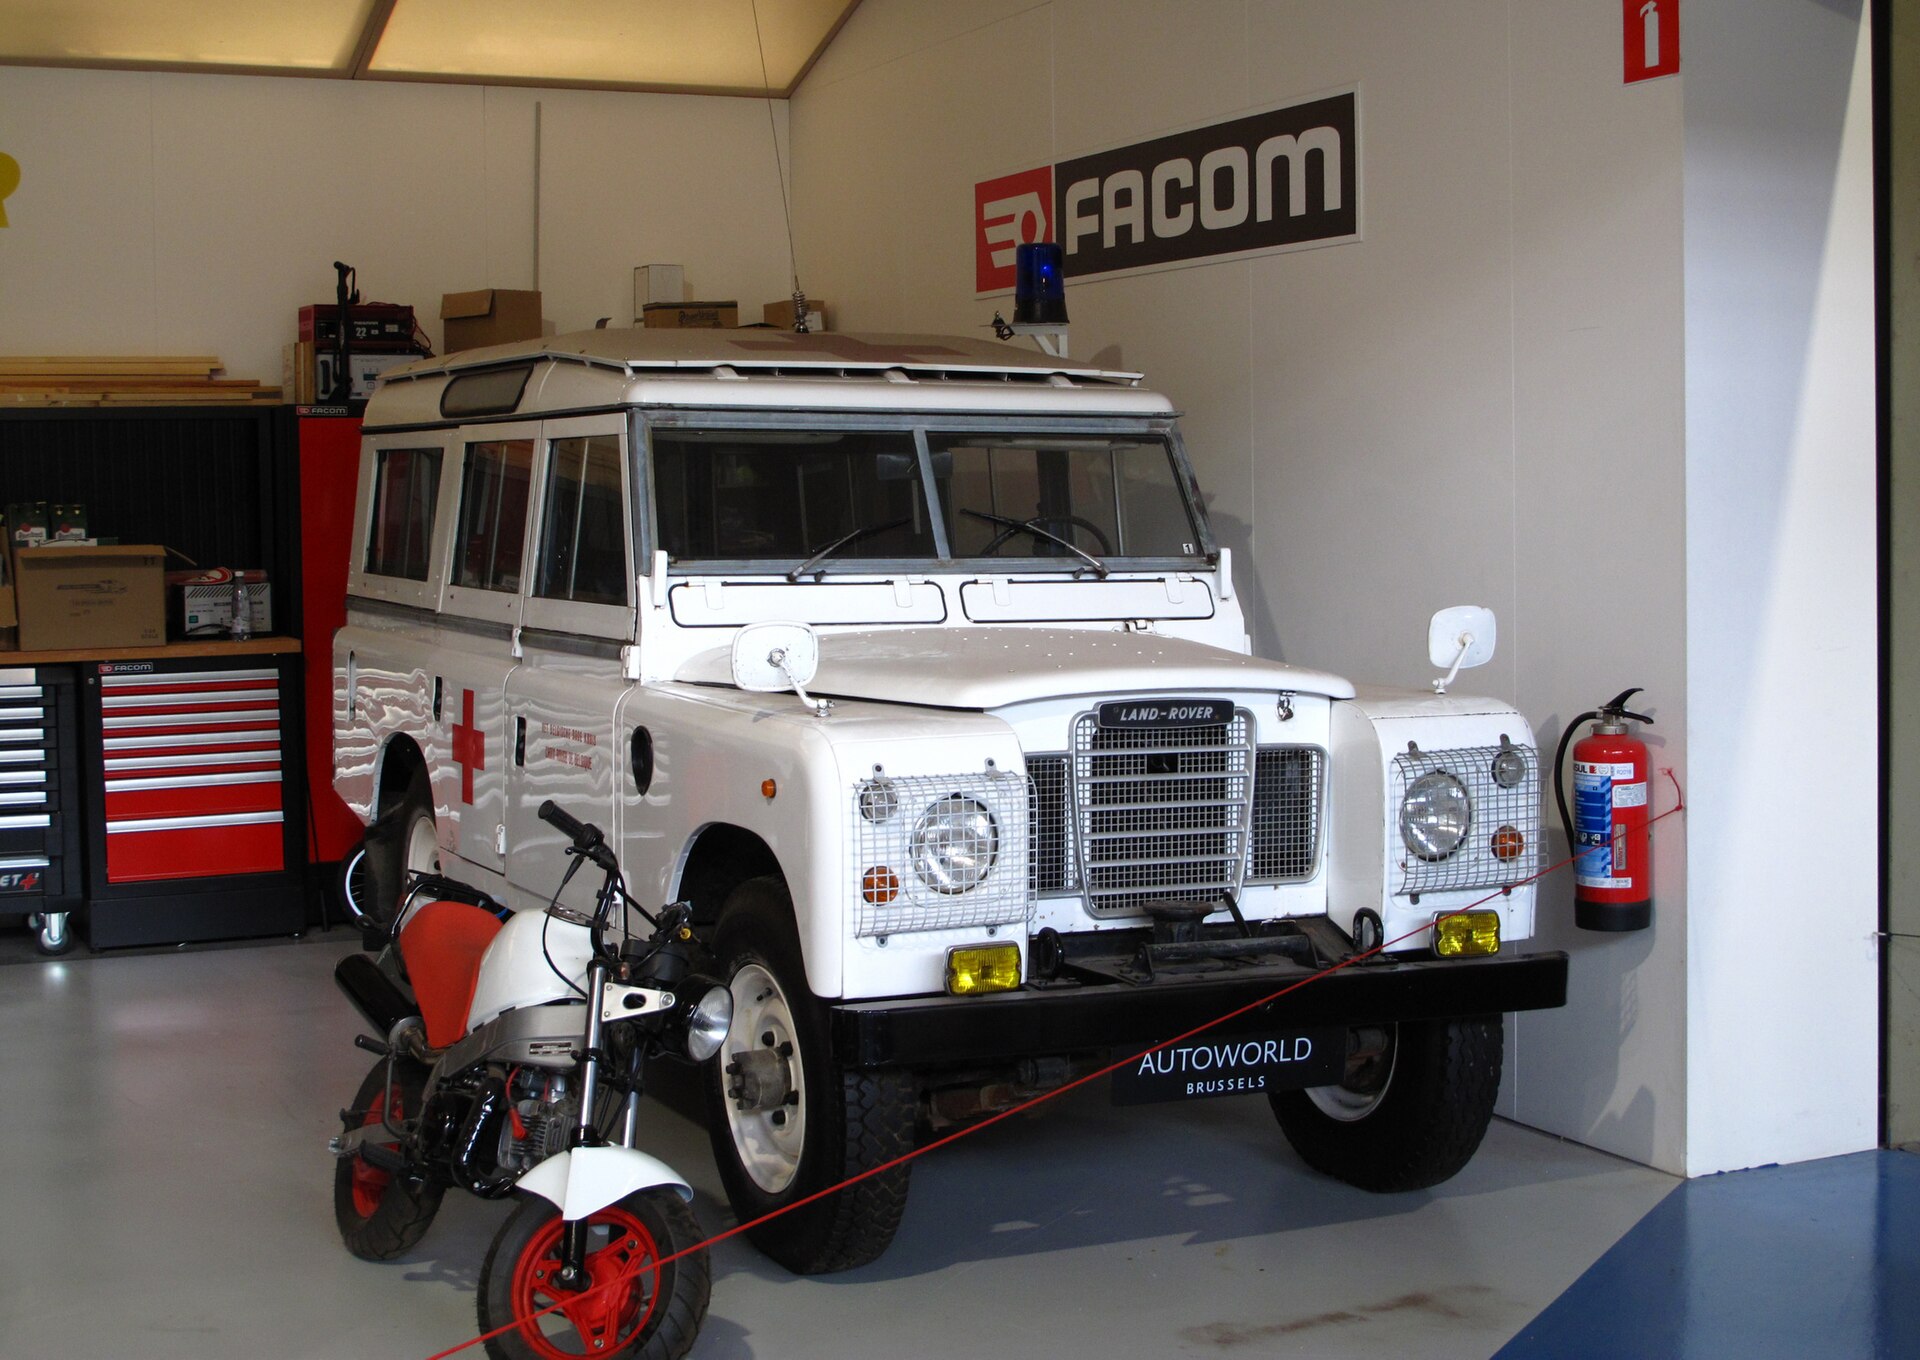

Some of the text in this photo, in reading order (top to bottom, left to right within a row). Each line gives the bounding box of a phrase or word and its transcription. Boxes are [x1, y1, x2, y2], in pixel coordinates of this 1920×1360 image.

[1065, 125, 1341, 256] FACOM
[355, 327, 367, 337] 22
[1120, 706, 1213, 721] LAND-ROVER
[1138, 1037, 1313, 1076] AUTOWORLD
[1186, 1075, 1266, 1095] BRUSSELS
